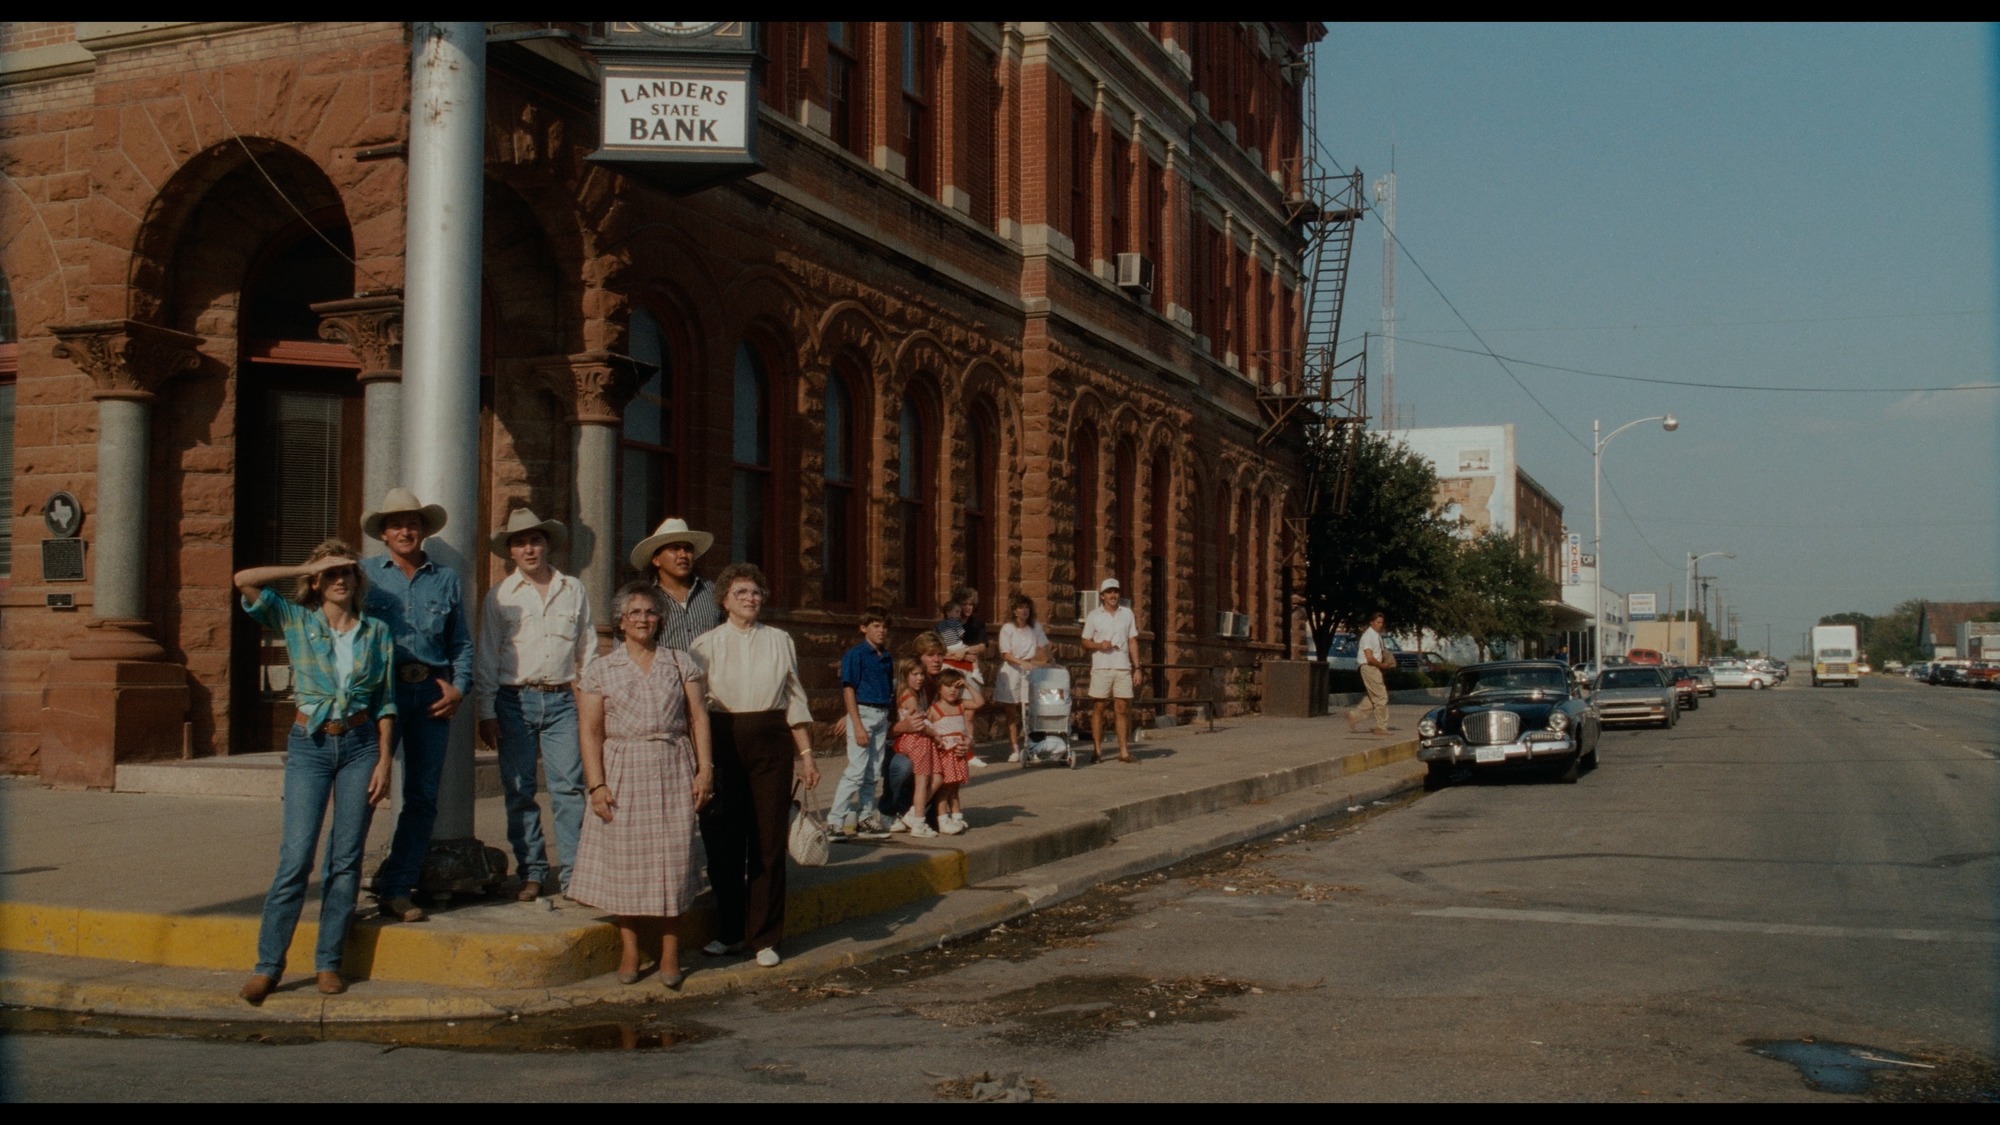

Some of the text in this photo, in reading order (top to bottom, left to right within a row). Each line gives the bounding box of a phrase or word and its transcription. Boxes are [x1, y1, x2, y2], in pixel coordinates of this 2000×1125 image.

[620, 81, 728, 106] LANDERS
[651, 104, 700, 116] STATE
[629, 118, 719, 142] BANK
